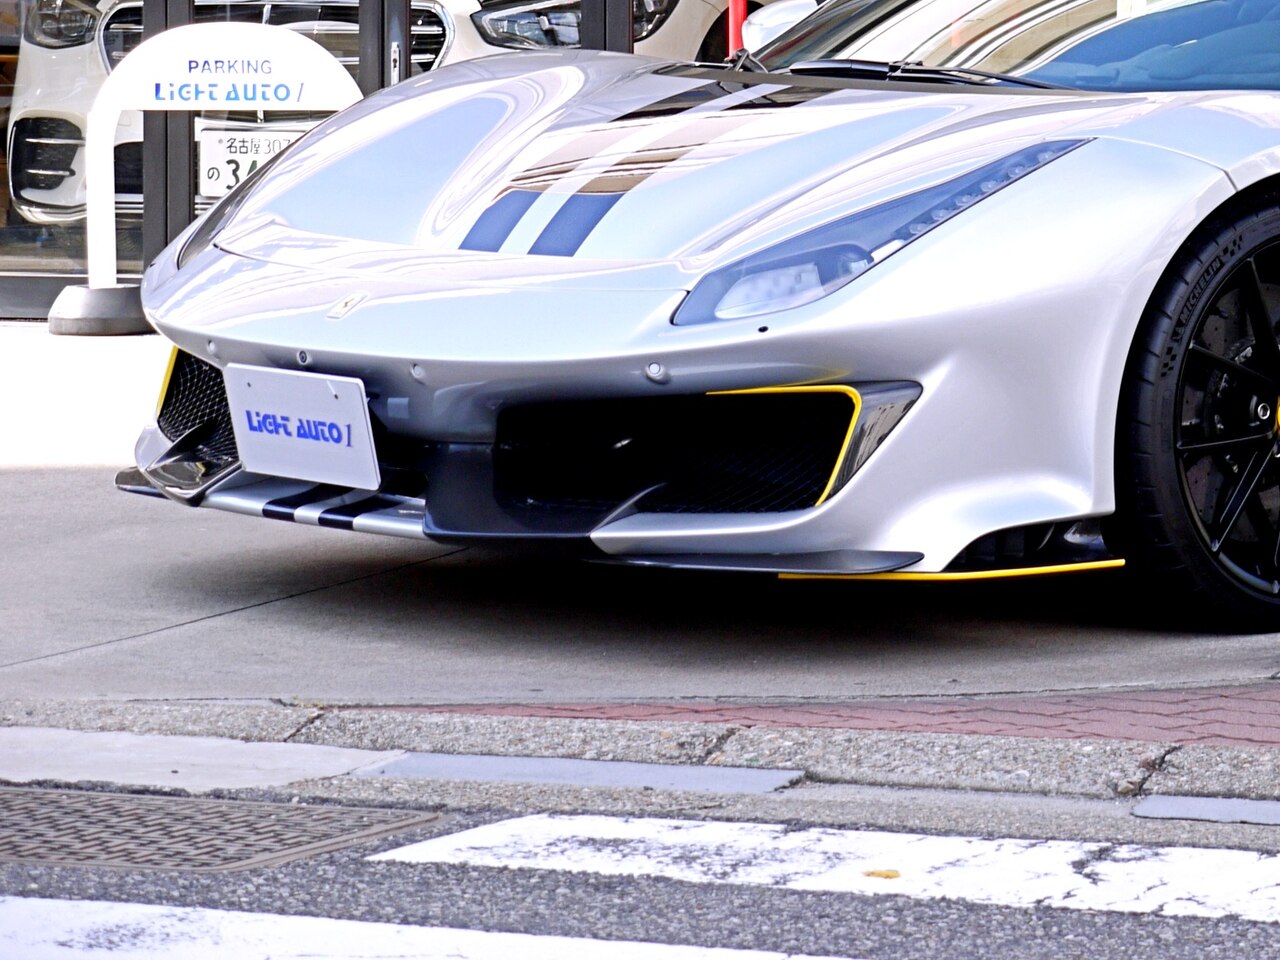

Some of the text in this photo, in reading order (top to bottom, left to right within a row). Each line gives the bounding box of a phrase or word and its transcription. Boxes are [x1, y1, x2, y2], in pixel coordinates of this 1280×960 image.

[188, 60, 272, 74] PARKING
[225, 83, 291, 102] AUTO
[226, 137, 261, 155] 名古屋
[207, 166, 221, 181] の
[1178, 255, 1225, 325] MICHELIN
[296, 418, 343, 444] AUTO
